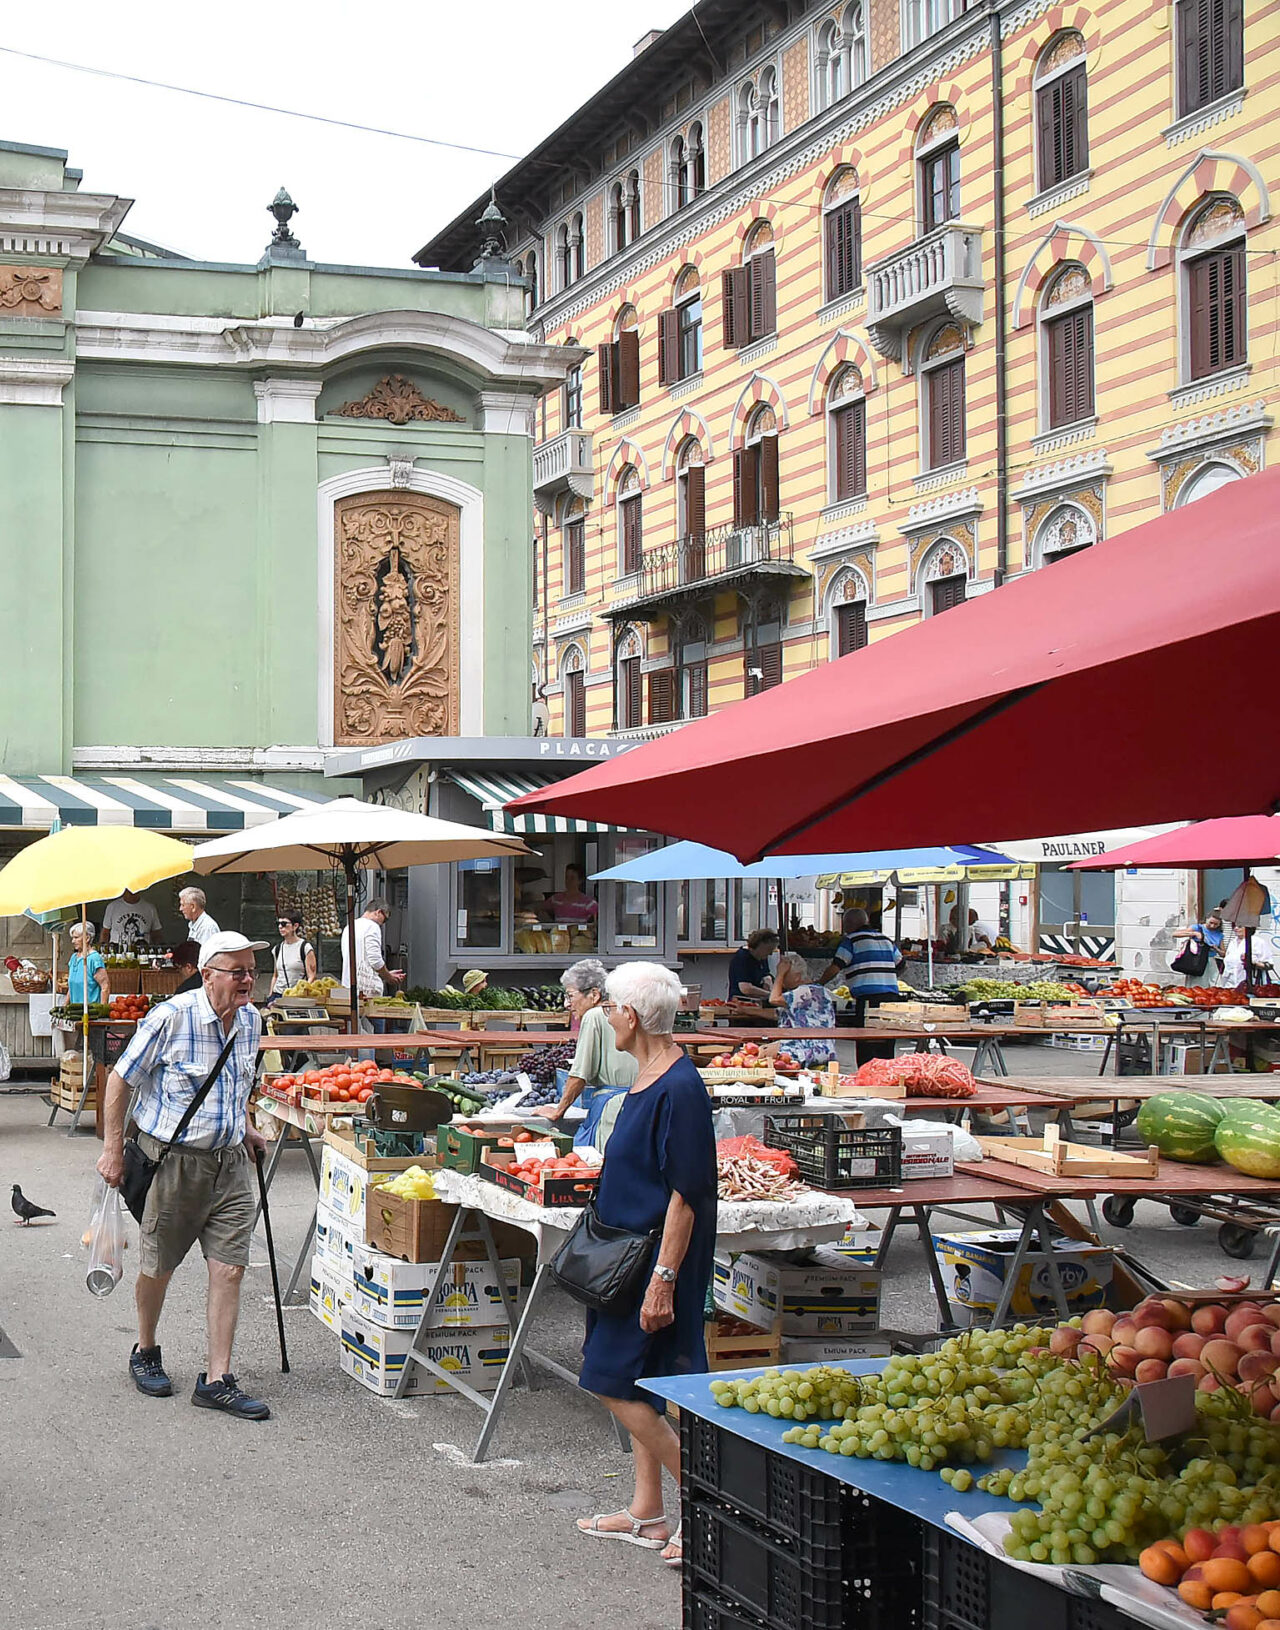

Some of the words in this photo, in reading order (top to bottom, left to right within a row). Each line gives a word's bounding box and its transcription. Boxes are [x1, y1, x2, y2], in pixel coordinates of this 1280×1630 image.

[540, 742, 610, 756] PLACA
[1041, 841, 1106, 857] PAULANER
[720, 1096, 749, 1104] ROYAL
[764, 1096, 791, 1104] FRUIT
[466, 1266, 484, 1274] PACK
